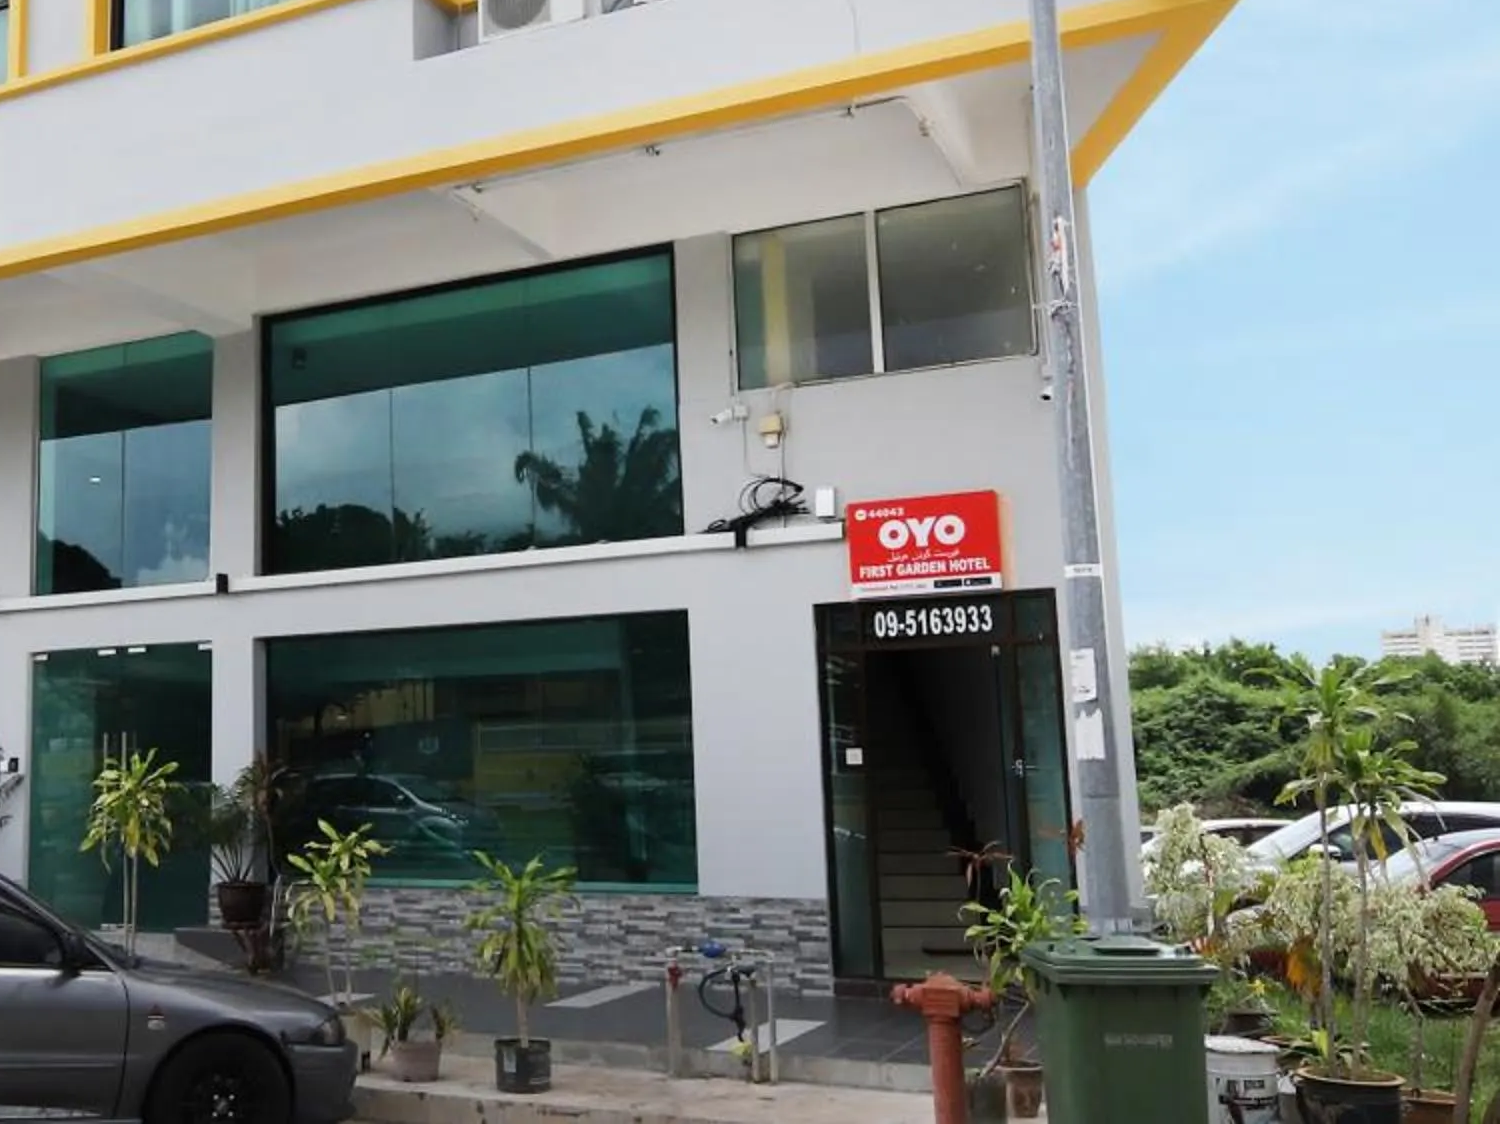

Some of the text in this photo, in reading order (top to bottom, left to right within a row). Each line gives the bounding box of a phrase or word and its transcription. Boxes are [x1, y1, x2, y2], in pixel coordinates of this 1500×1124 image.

[878, 514, 966, 549] OYO
[859, 563, 896, 579] FIRST
[896, 559, 947, 577] GARDEN
[949, 556, 991, 573] HOTEL
[874, 604, 994, 639] 09-5163933
